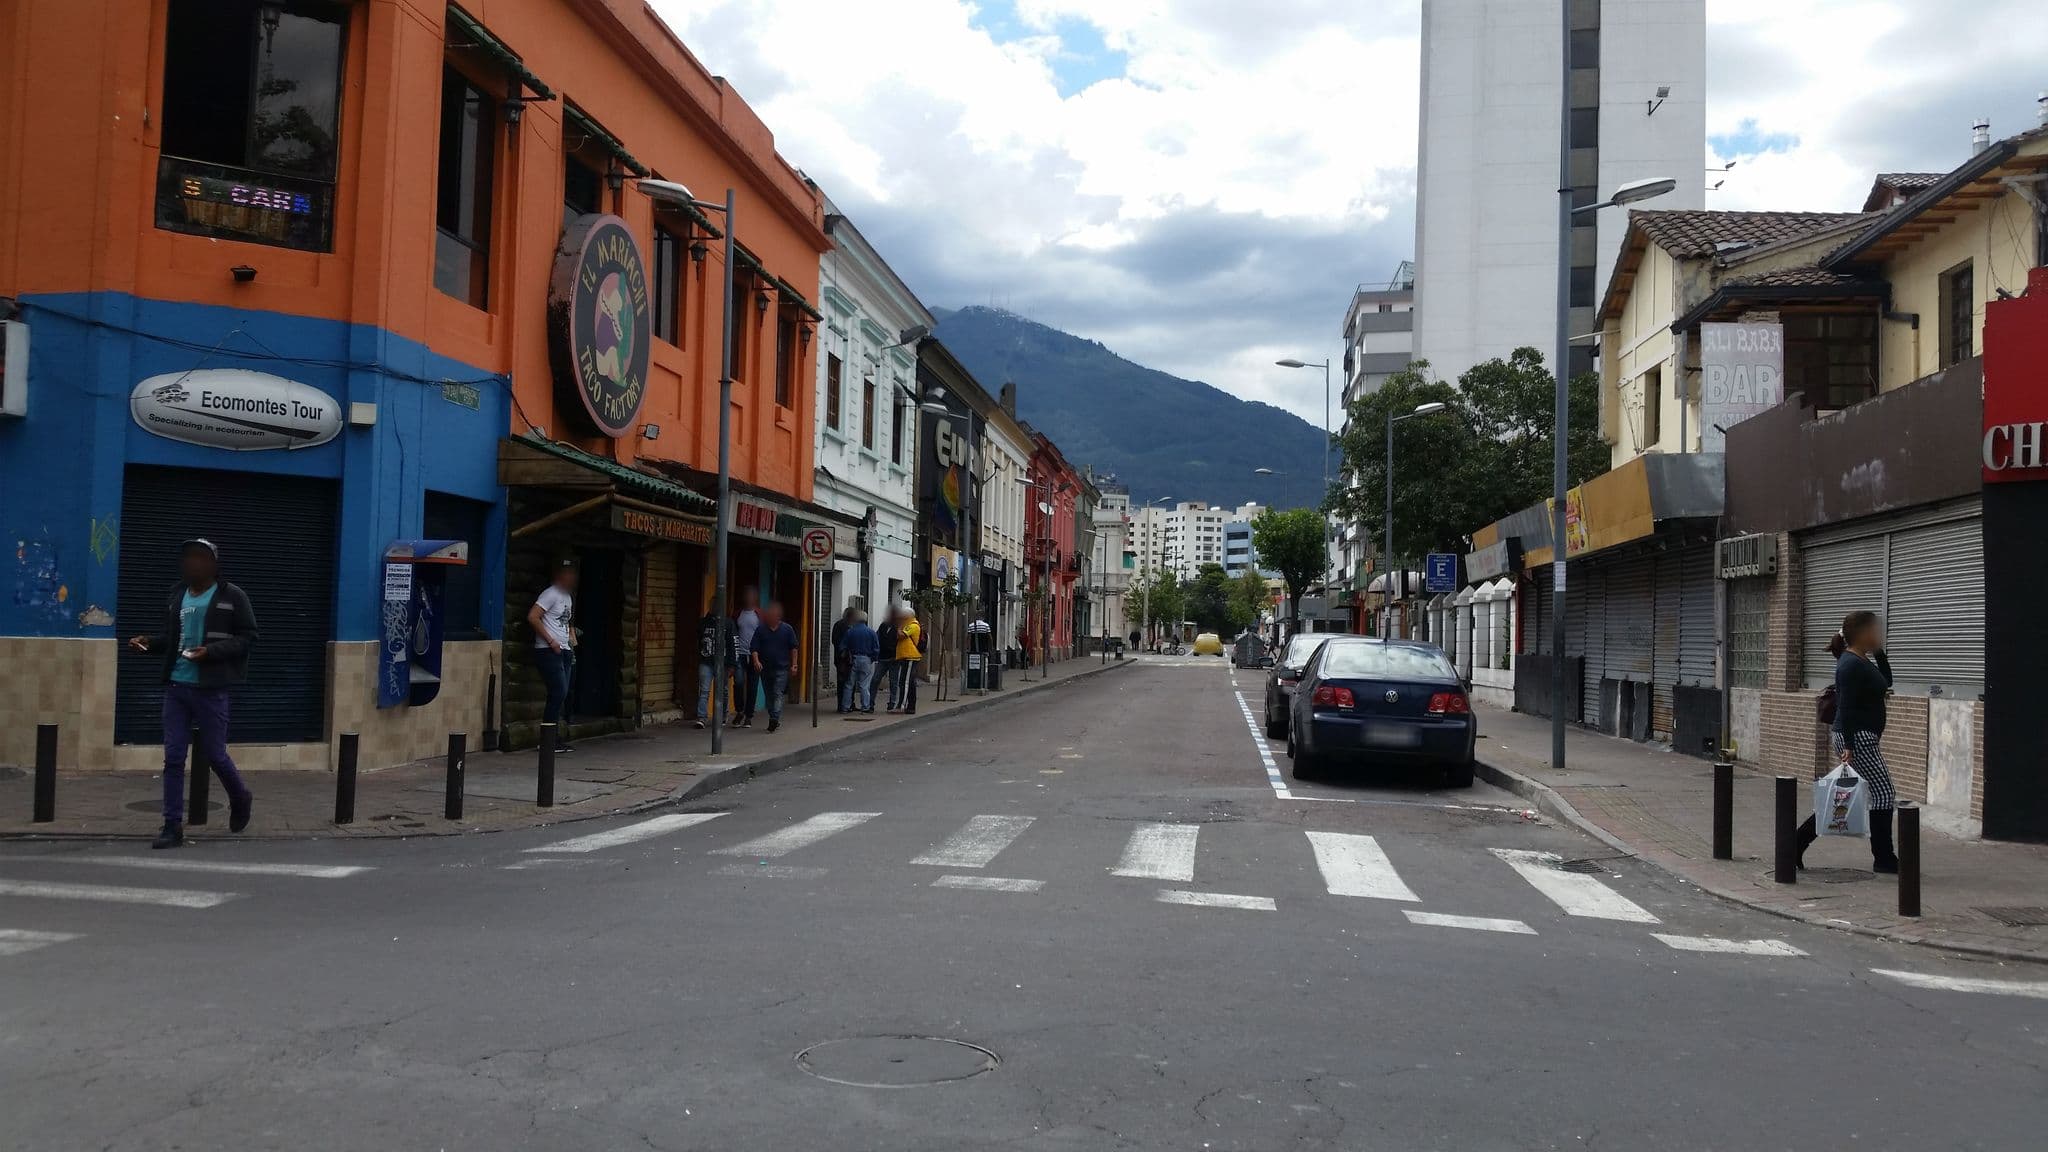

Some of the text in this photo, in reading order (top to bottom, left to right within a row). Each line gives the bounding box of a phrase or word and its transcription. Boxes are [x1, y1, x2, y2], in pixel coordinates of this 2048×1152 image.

[582, 263, 597, 294] EL
[1736, 328, 1781, 353] BABA
[580, 344, 641, 420] TACO FACTORY
[1705, 364, 1778, 405] BAR
[201, 391, 323, 421] Ecomontes Tour
[148, 413, 265, 437] Specializing in ecotourism
[1982, 421, 2048, 471] CH
[623, 511, 655, 534] TACOS
[1437, 562, 1447, 577] E
